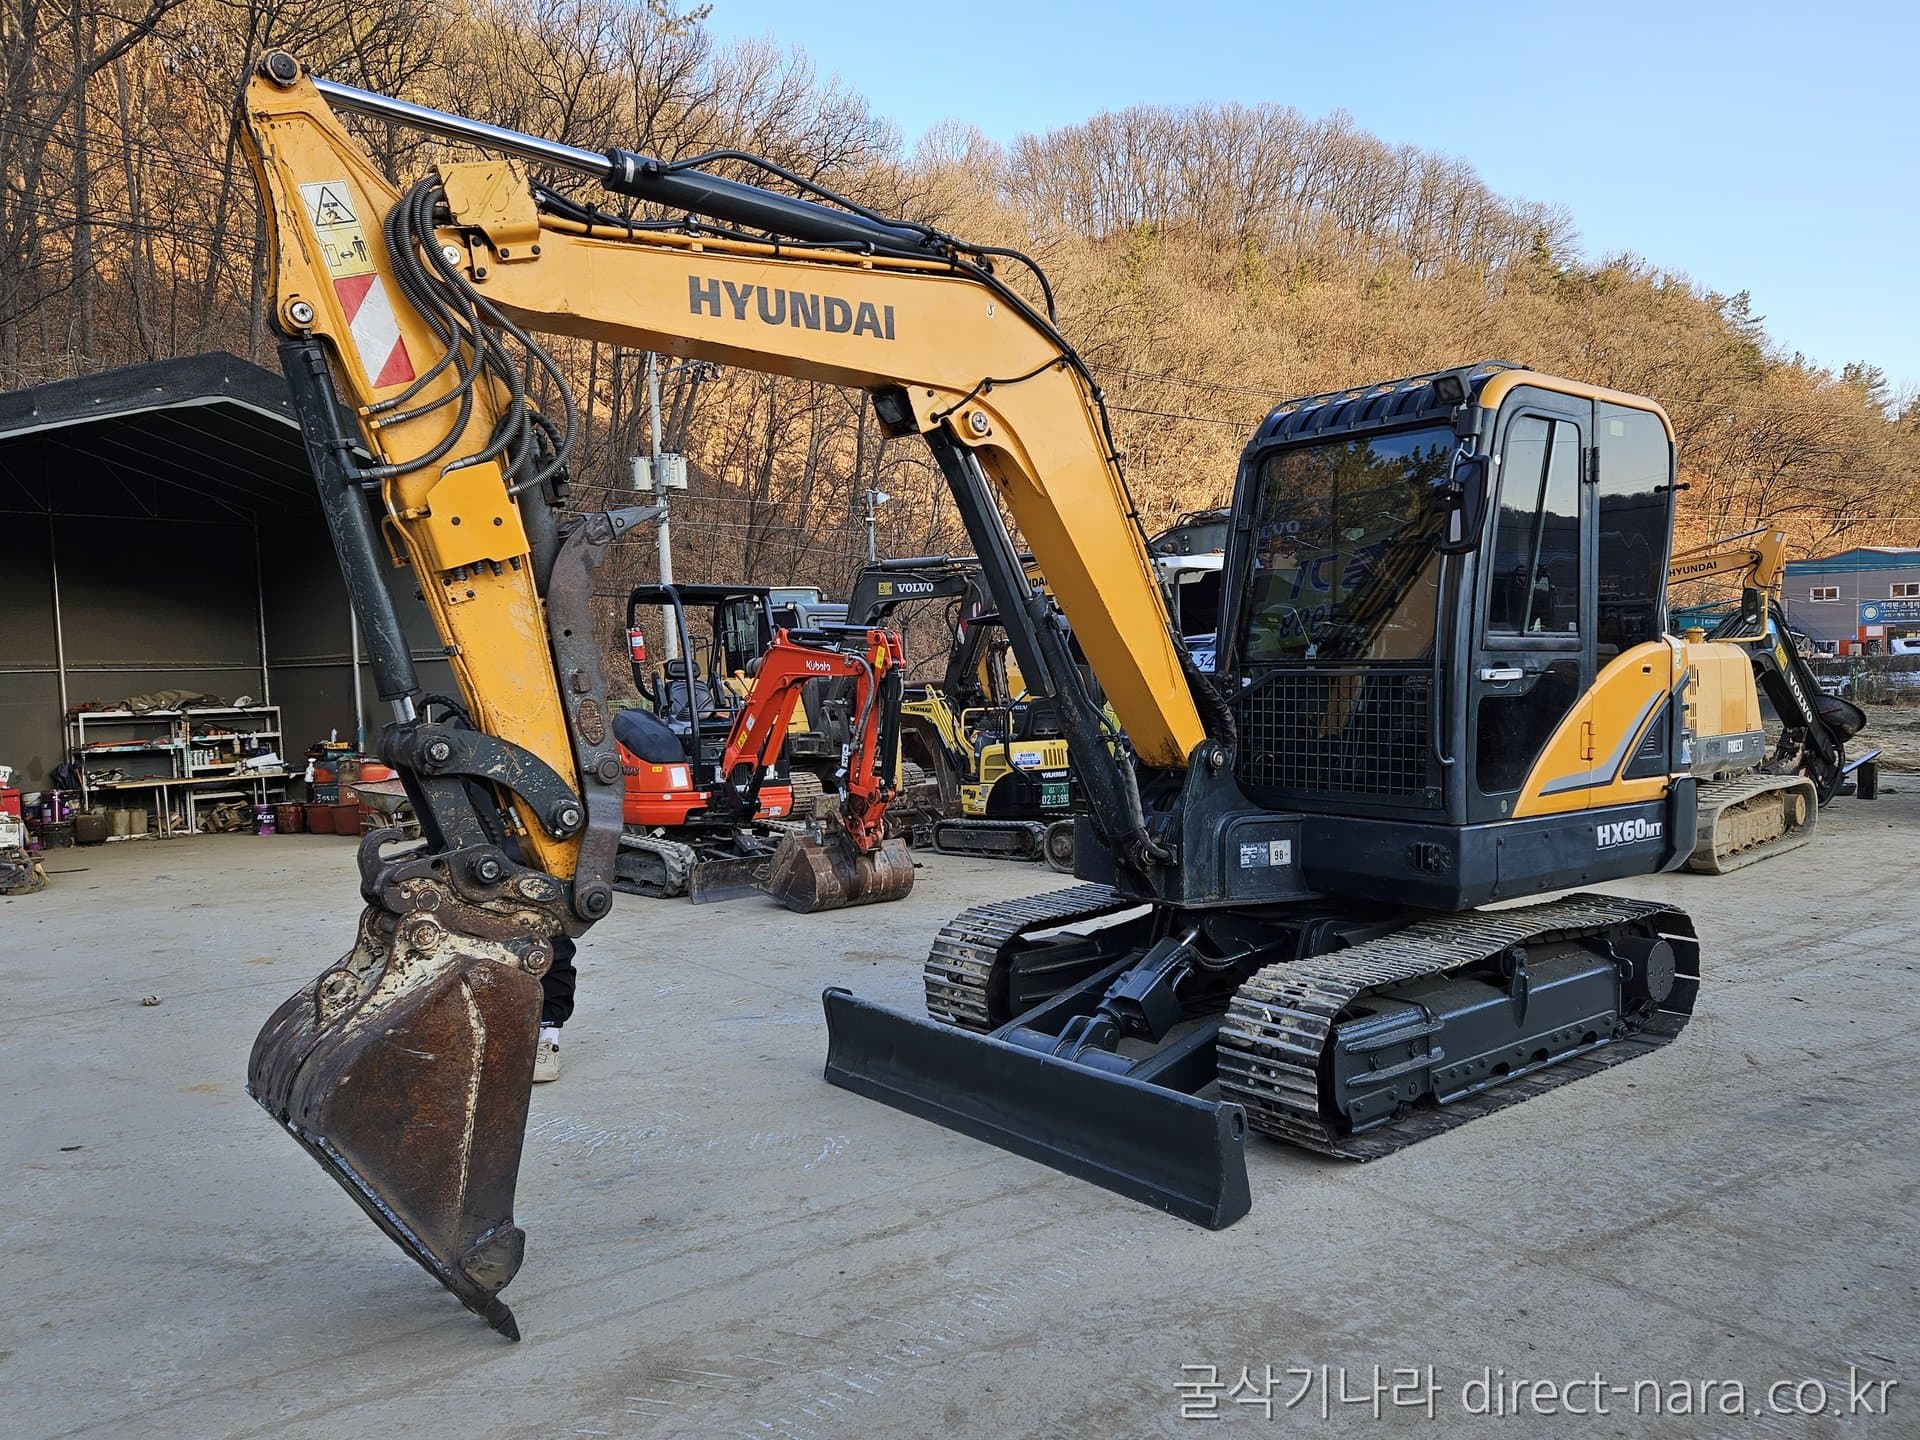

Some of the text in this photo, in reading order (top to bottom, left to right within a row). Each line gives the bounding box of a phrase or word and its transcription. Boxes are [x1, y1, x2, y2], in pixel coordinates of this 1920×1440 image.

[688, 275, 896, 341] HYUNDAI
[1668, 561, 1717, 577] HYUNDAI
[897, 582, 934, 593] VOLVO
[806, 660, 831, 671] Kubota
[1790, 671, 1813, 723] VOLVO
[1274, 850, 1284, 861] 98
